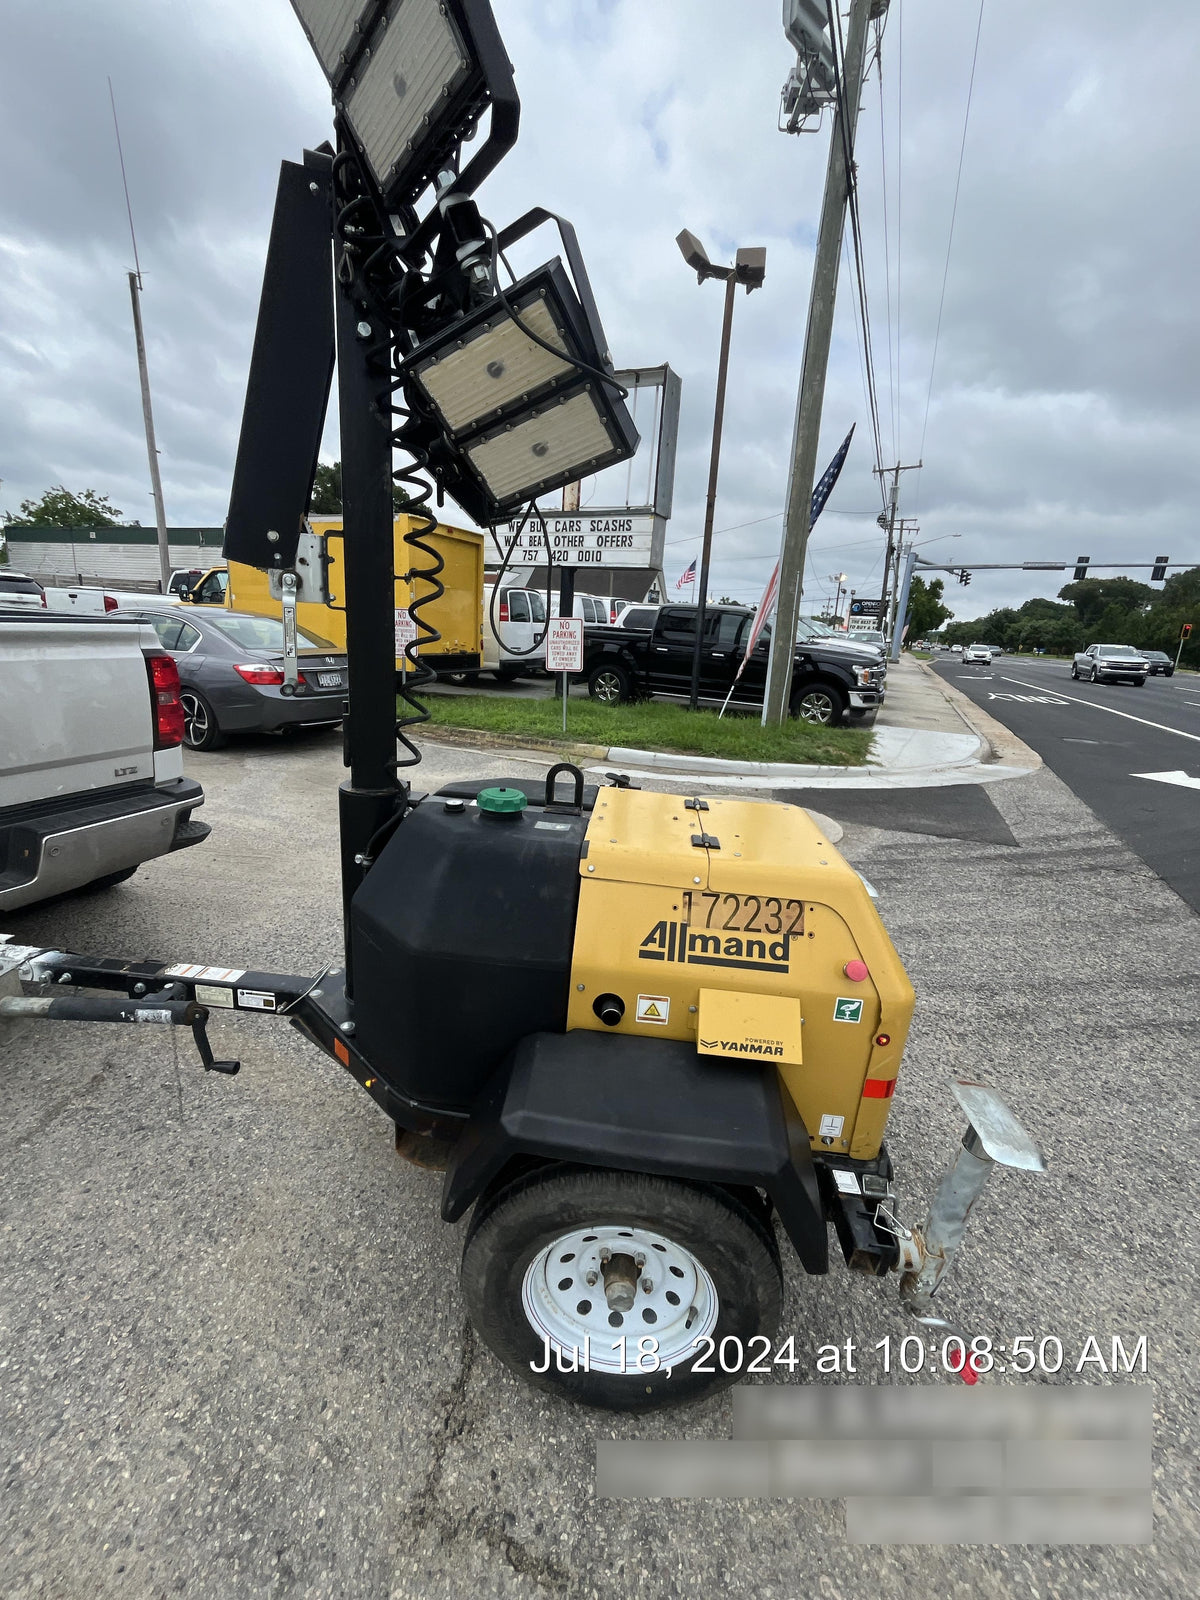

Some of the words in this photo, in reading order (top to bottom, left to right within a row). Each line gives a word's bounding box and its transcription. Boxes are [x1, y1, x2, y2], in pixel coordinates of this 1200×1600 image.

[555, 520, 581, 532] CARS
[590, 519, 632, 532] SCASHS
[554, 535, 584, 547] OTHER
[596, 535, 633, 547] OFFERS
[523, 550, 538, 561] 757
[551, 550, 568, 562] 420
[578, 550, 602, 562] 0010
[397, 611, 407, 619] NO
[559, 621, 570, 630] NO
[552, 630, 577, 639] PARKING
[683, 891, 804, 936] 172232
[639, 921, 790, 963] Allmand
[745, 1037, 775, 1046] POWERED
[720, 1040, 784, 1056] YANMAR
